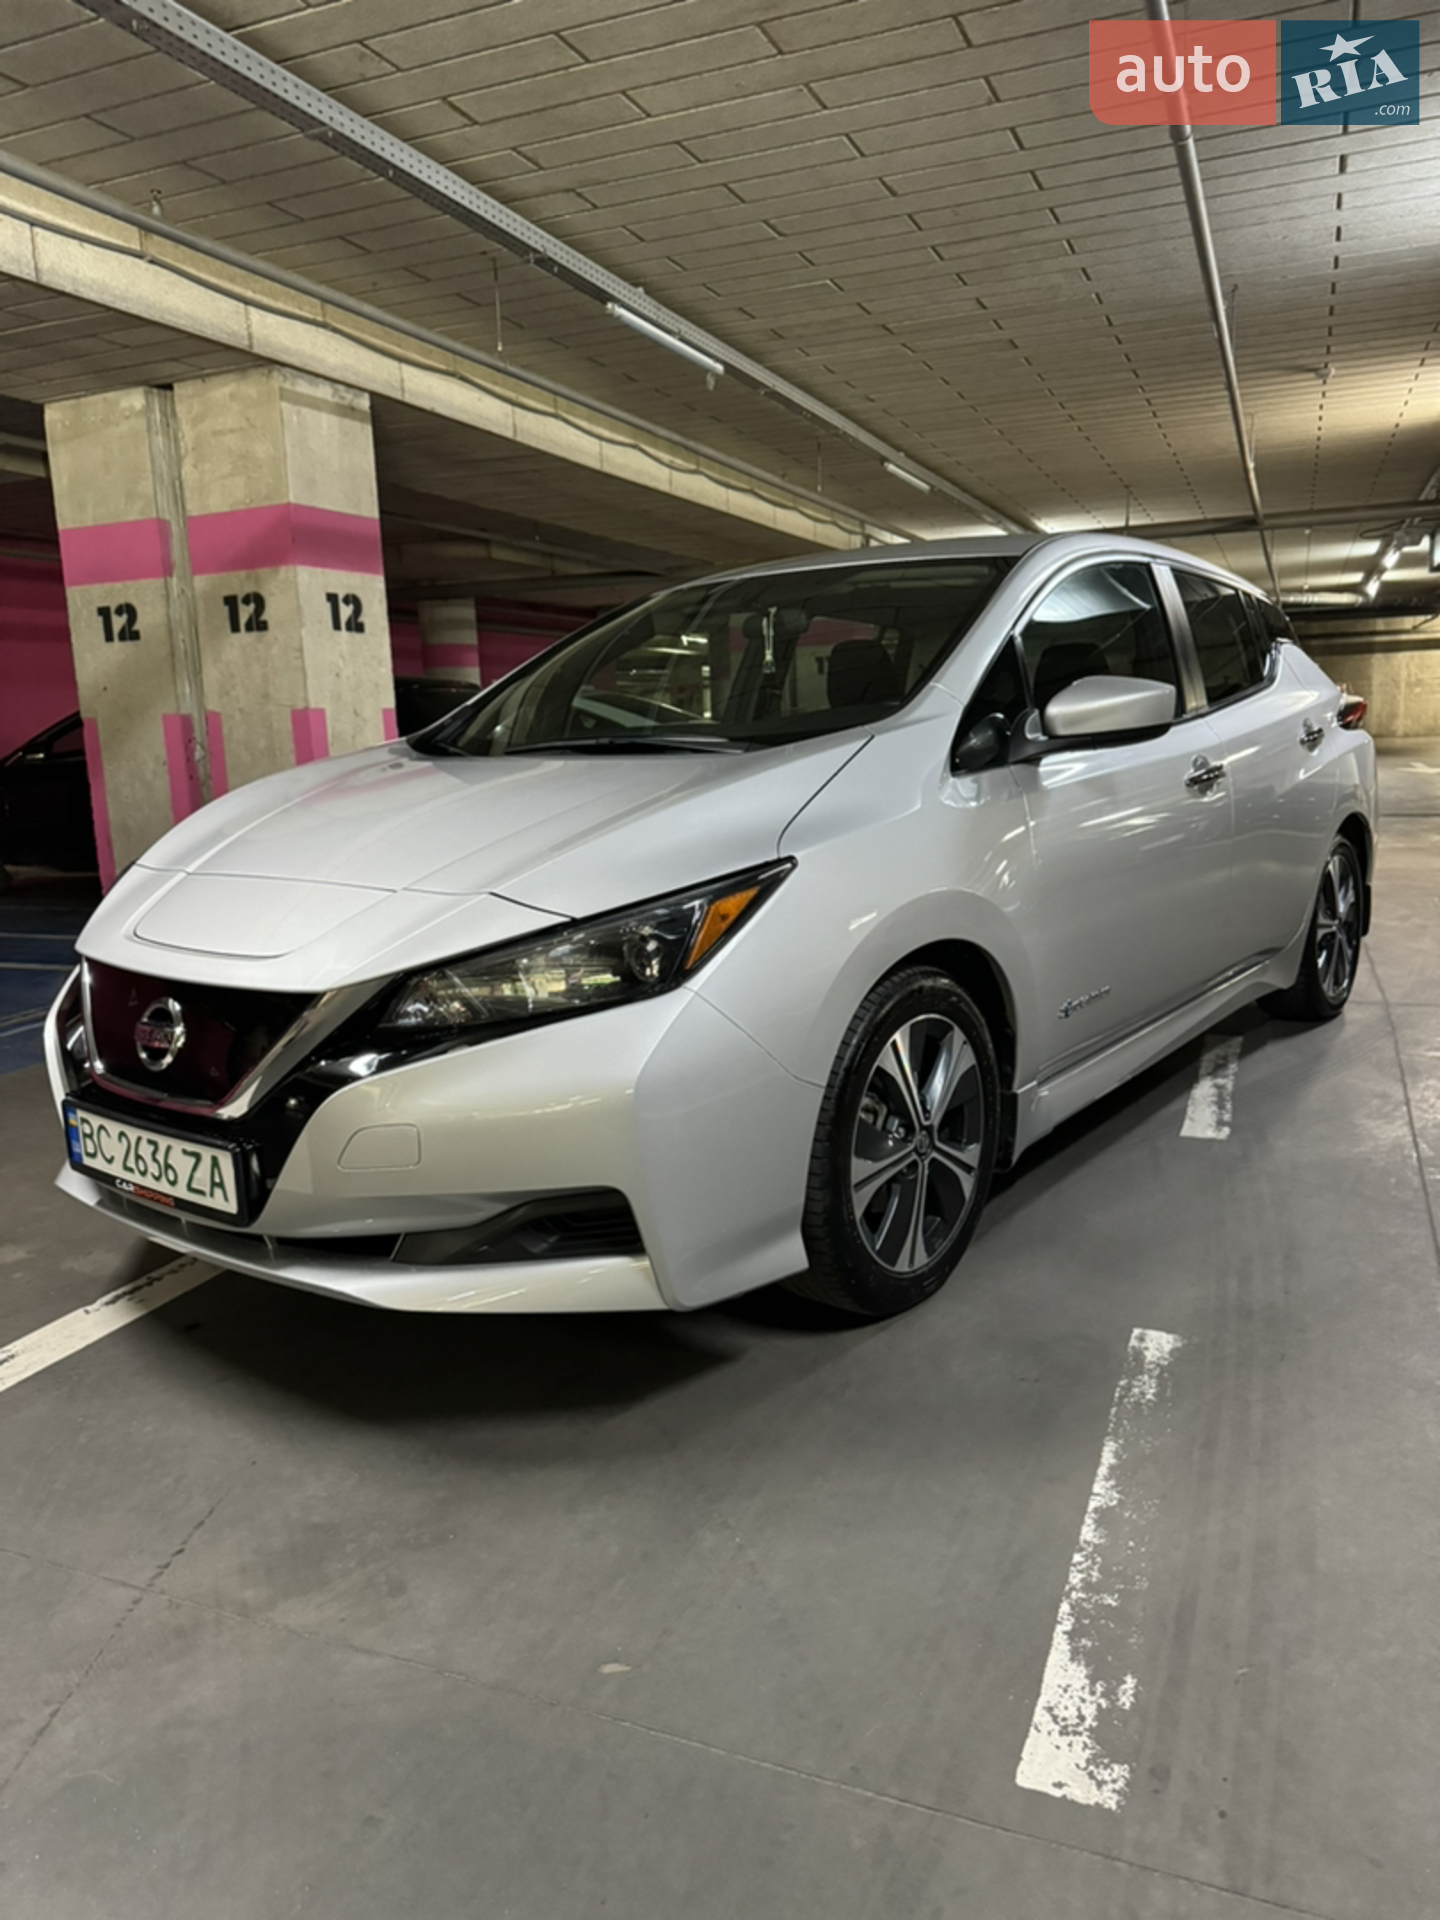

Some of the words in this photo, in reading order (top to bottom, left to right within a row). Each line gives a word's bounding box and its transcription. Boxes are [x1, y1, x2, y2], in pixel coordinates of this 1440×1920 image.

[97, 602, 141, 643] 12
[222, 591, 269, 634] 12
[325, 591, 366, 634] 12
[80, 1116, 115, 1165] BC
[117, 1130, 178, 1187] 2636
[181, 1148, 230, 1203] ZA
